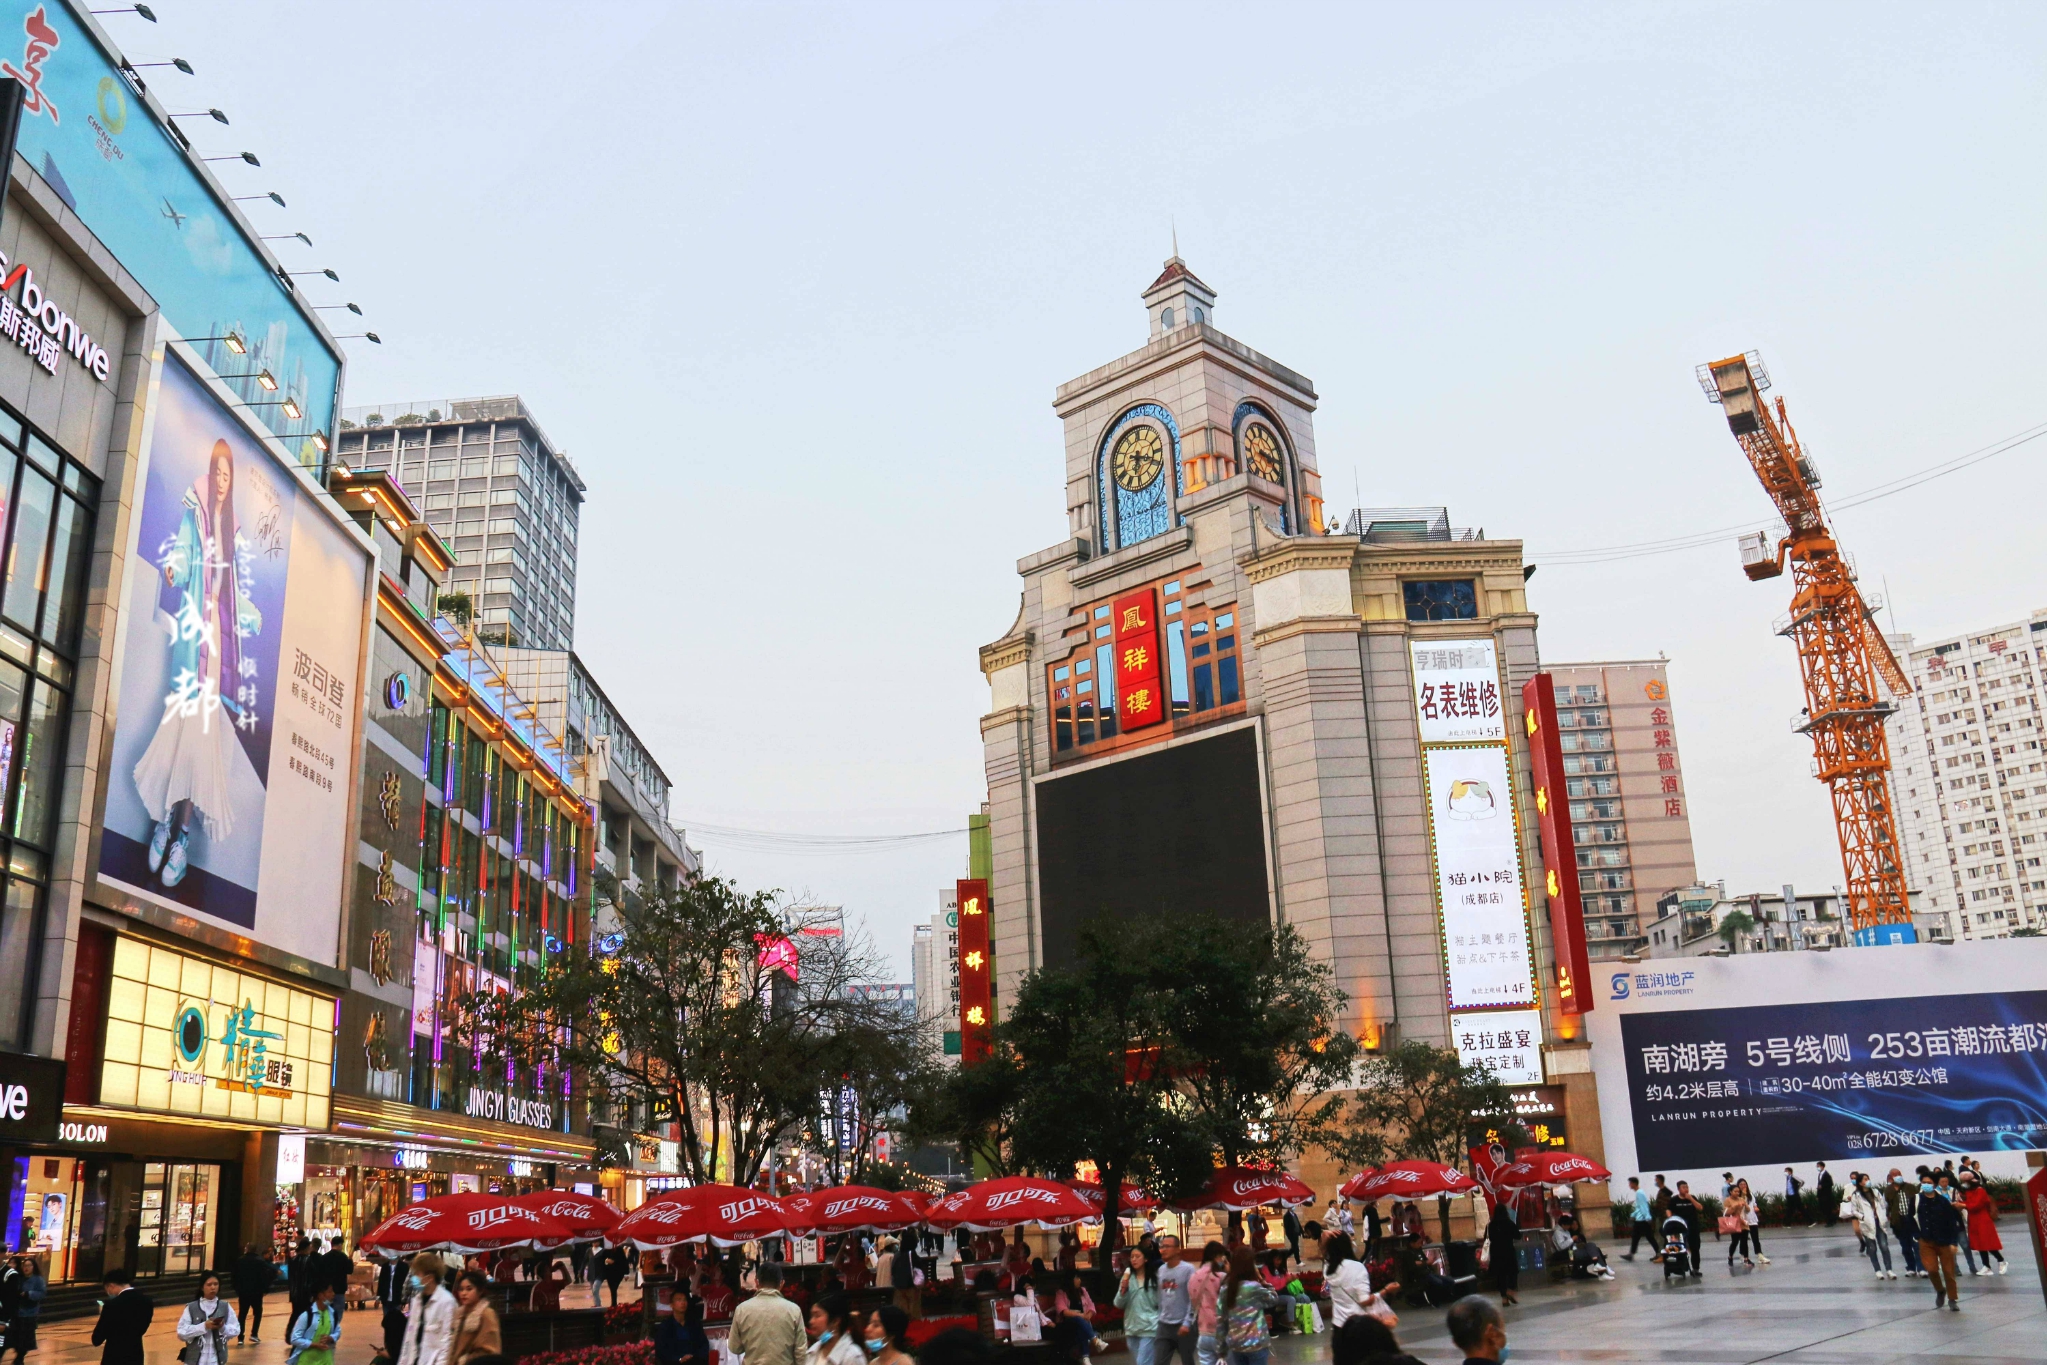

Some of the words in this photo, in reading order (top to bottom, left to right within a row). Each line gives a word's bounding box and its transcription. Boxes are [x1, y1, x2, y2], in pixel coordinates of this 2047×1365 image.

[112, 144, 124, 160] DU
[292, 647, 346, 710] 波司登
[1420, 680, 1500, 720] 名表维修
[1487, 726, 1501, 737] 5F
[1650, 706, 1682, 818] 金紫薇酒店
[1447, 869, 1513, 886] 猫小院
[1461, 892, 1504, 906] (成都店)
[1454, 932, 1518, 947] 猫主题餐厅
[1456, 951, 1520, 965] 甜点&下午茶
[1511, 982, 1526, 994] 4F
[1634, 971, 1695, 990] 蓝润地产
[1637, 990, 1663, 998] LANRUN
[1663, 988, 1694, 996] PROPERTY
[1460, 1029, 1532, 1052] 克拉盛宴
[1471, 1053, 1525, 1071] 珠宝定制
[1641, 1040, 1729, 1075] 南湖旁
[1746, 1033, 1852, 1067] 5号线侧
[1527, 1071, 1540, 1081] 2F
[1645, 1079, 1740, 1102] 约4.2米层高
[466, 1087, 504, 1121] JINGYI
[508, 1096, 552, 1130] GLASSES
[1651, 1112, 1697, 1122] LANRUN
[1702, 1107, 1762, 1119] PROPERTY
[1847, 1140, 1863, 1149] 028
[1863, 1132, 1898, 1149] 6728
[1901, 1129, 1934, 1146] 6677
[1549, 1158, 1593, 1176] Coca-Cola
[824, 1195, 891, 1219] 可口可乐
[985, 1187, 1061, 1211] 可口可乐
[467, 1204, 541, 1231] 可口可乐
[719, 1196, 785, 1224] 可口可乐
